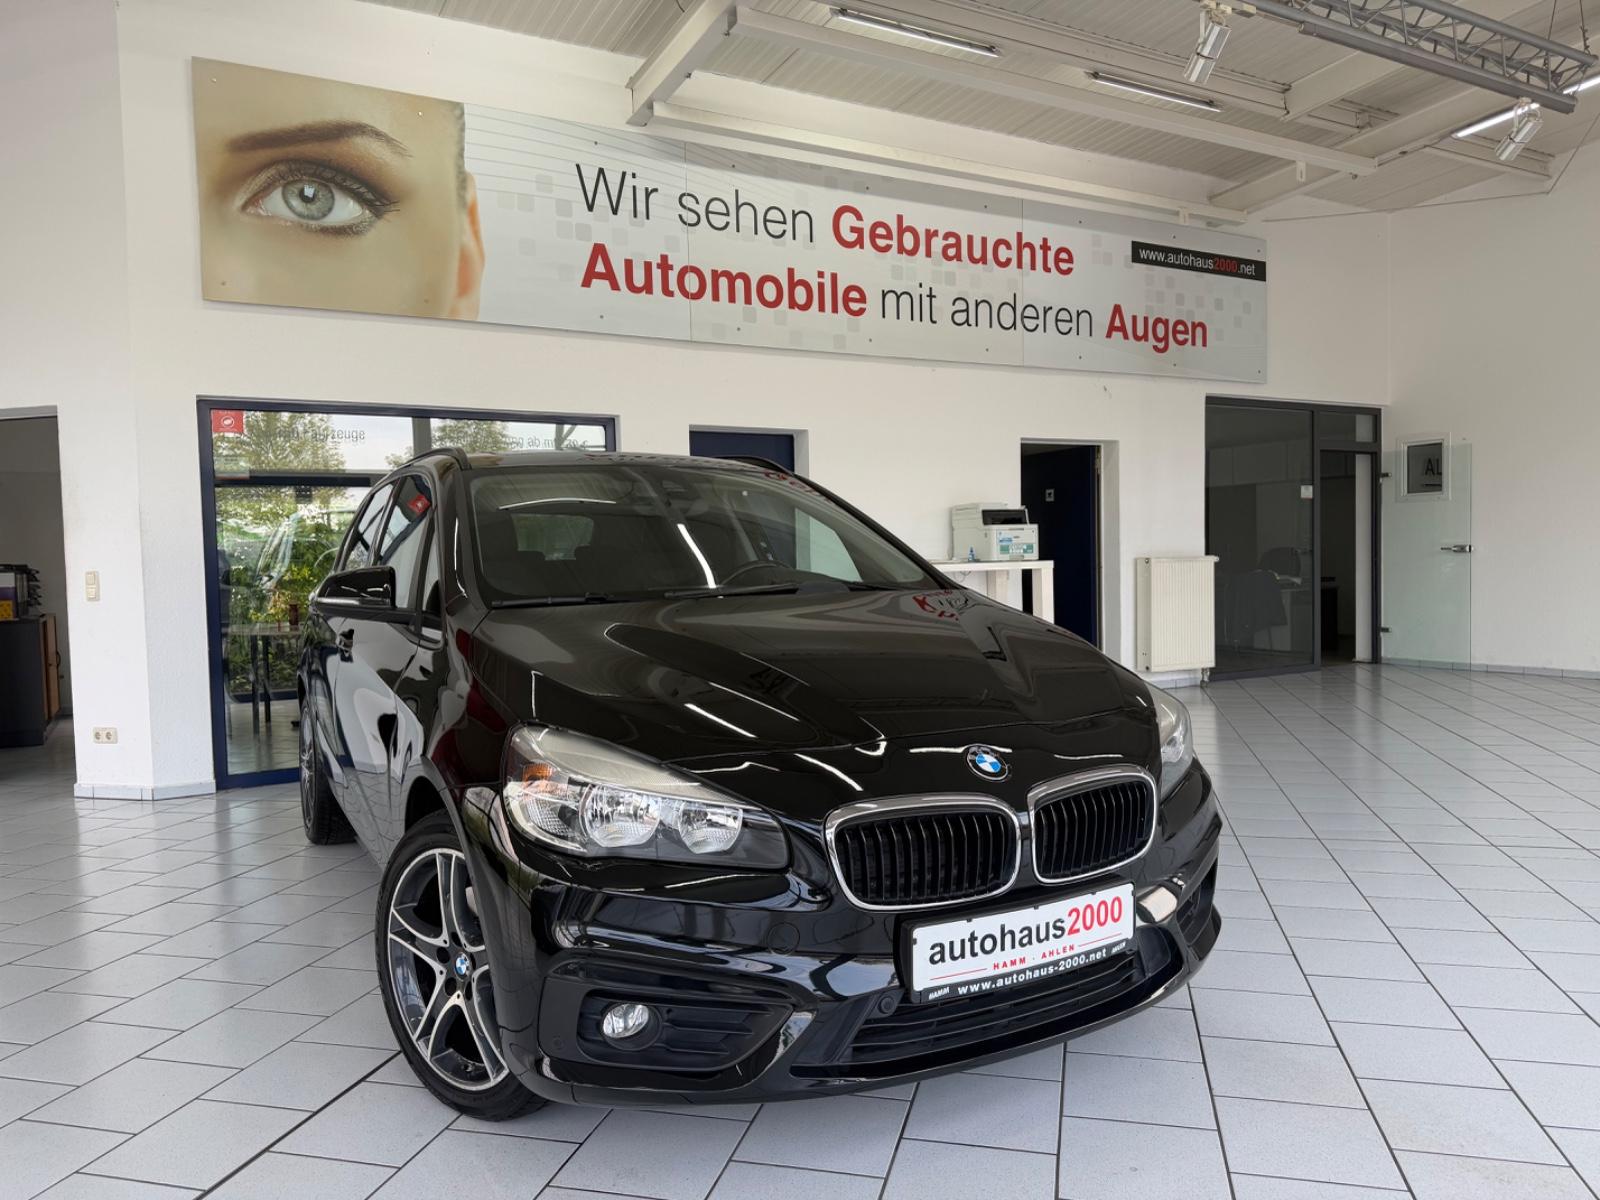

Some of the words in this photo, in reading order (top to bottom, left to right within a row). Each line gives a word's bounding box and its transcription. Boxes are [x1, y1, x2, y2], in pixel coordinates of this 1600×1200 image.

[575, 163, 659, 221] Wir
[677, 188, 814, 243] sehen
[831, 204, 1075, 276] Gebrauchte
[1139, 248, 1256, 276] www.autohaus2000.net
[580, 242, 868, 317] Automobile
[881, 282, 937, 324] mit
[950, 293, 1093, 337] anderen
[1105, 303, 1208, 353] Augen
[928, 896, 1123, 965] autohaus2000
[993, 956, 1026, 970] HAMM
[1041, 943, 1075, 960] AHLEN
[957, 948, 1107, 995] www.autohaus-2000.net
